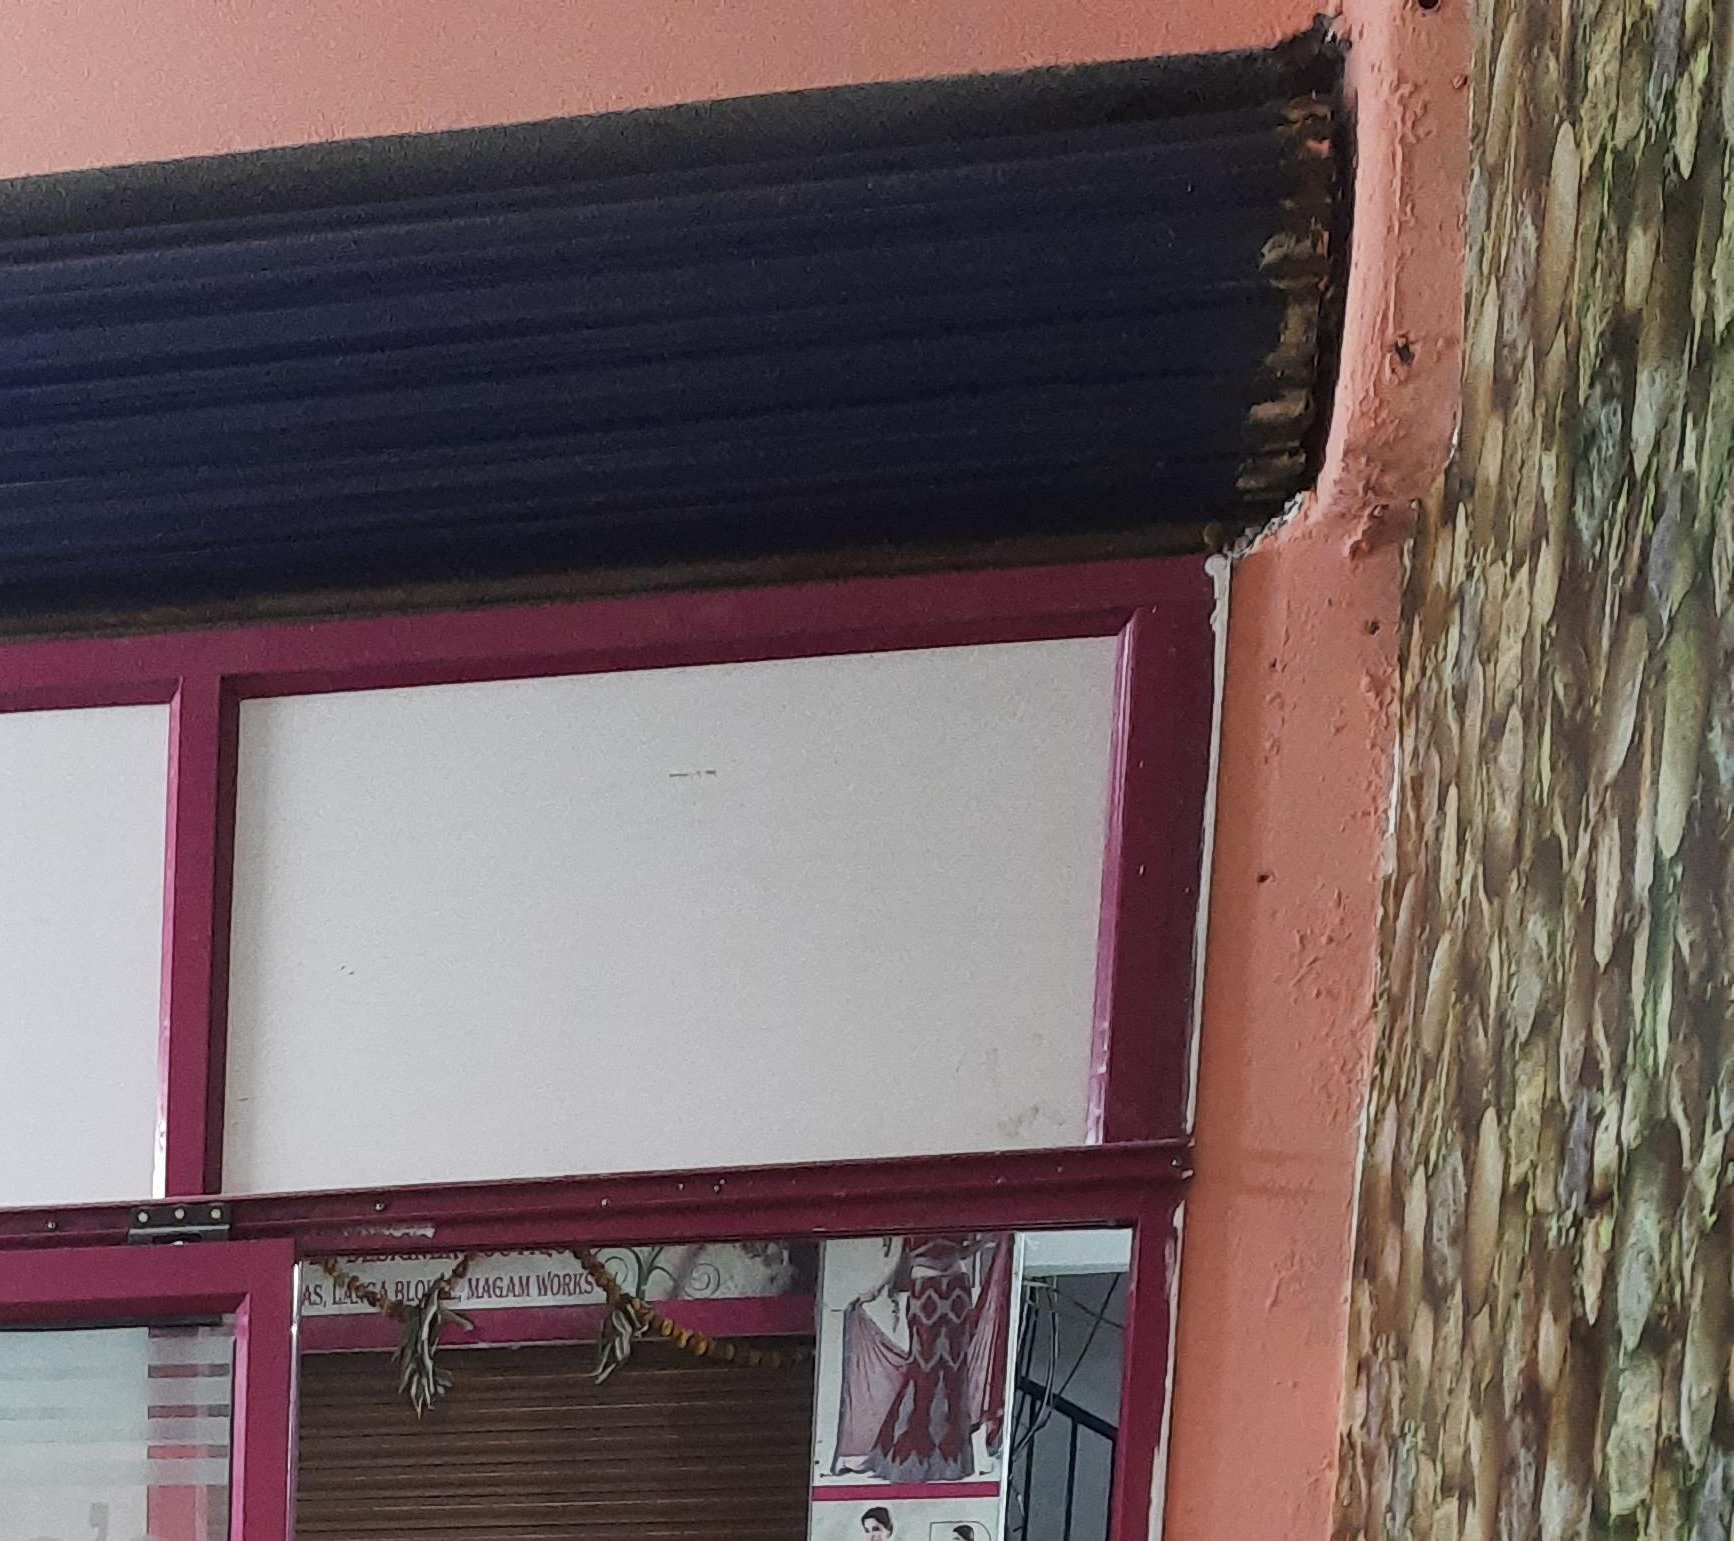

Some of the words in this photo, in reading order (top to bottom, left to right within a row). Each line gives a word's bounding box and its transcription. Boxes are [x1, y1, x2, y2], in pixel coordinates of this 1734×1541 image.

[332, 1279, 388, 1306] LAGA
[467, 1275, 531, 1300] MAGAM
[536, 1270, 594, 1298] WORKS
